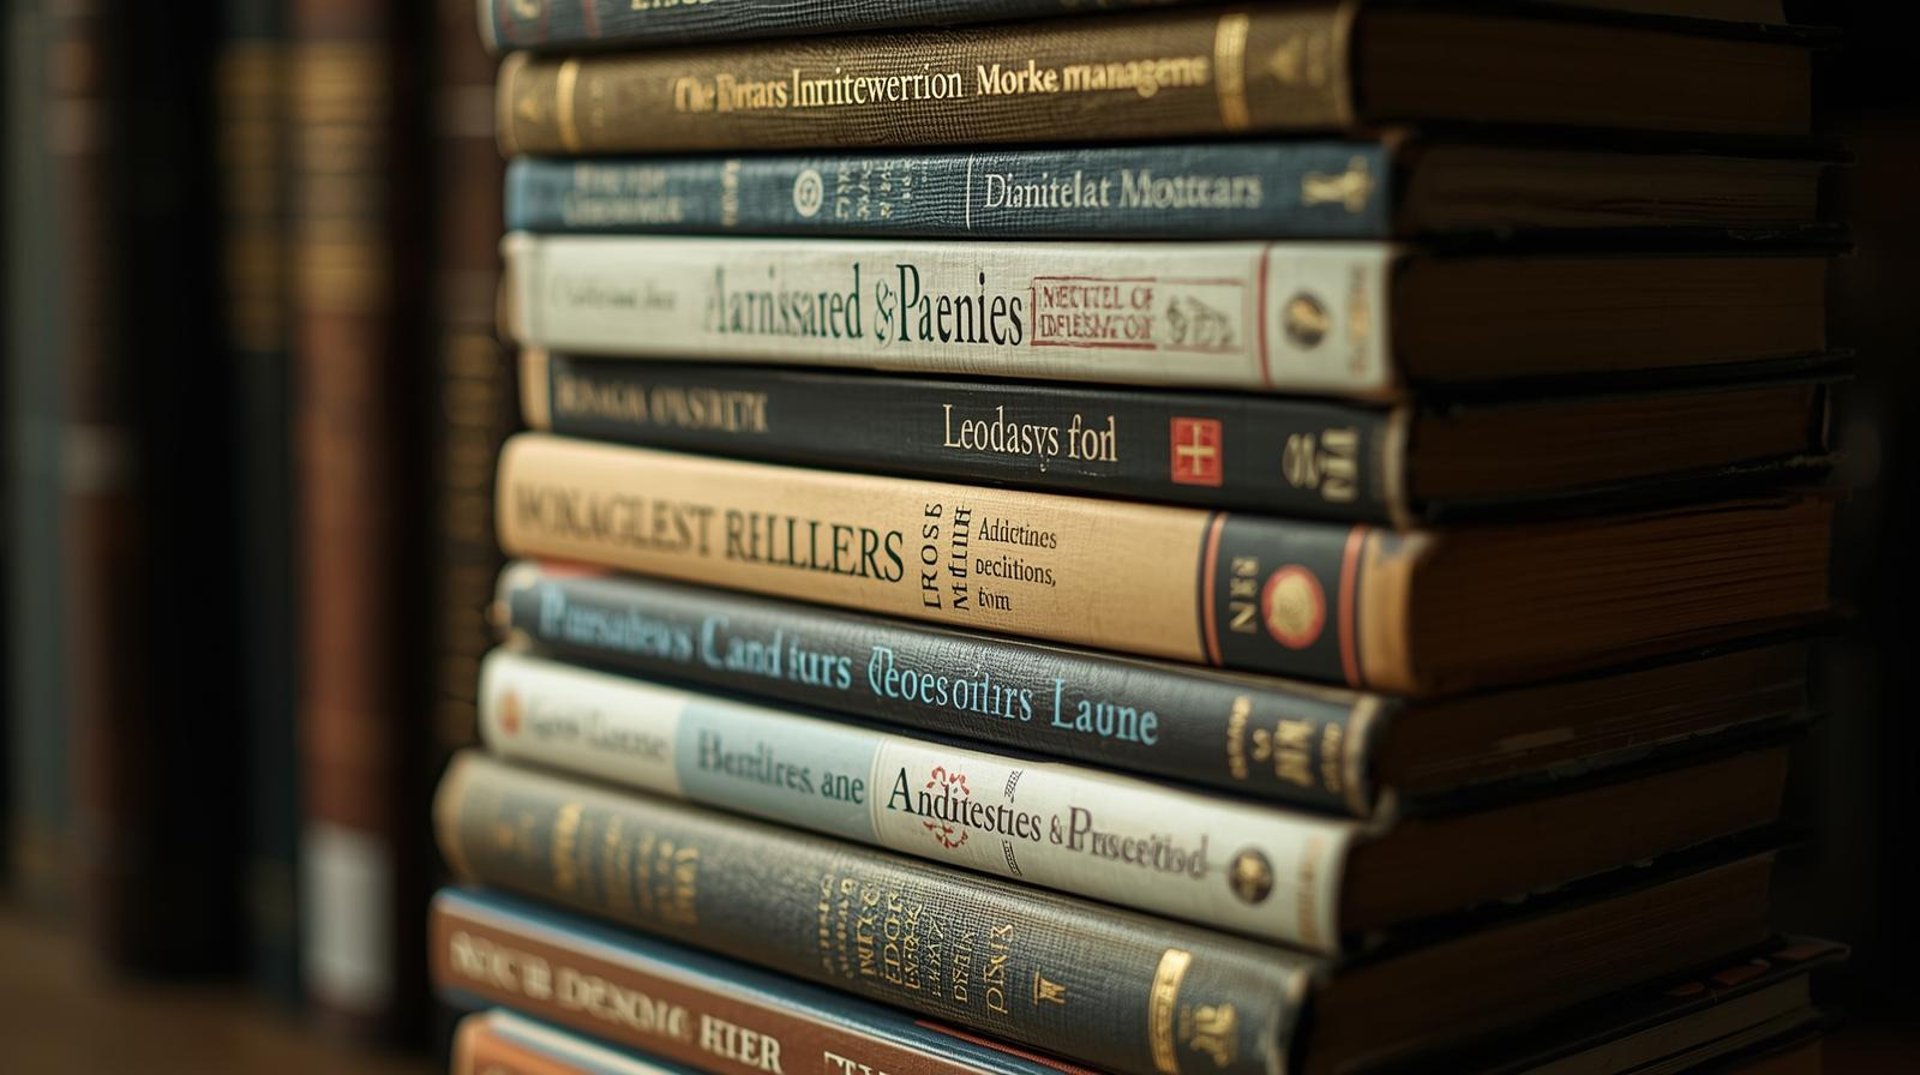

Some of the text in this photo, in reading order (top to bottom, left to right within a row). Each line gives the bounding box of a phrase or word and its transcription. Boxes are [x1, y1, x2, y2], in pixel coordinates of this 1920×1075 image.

[976, 60, 1058, 95] Morke
[896, 264, 1023, 346] Paenies
[1051, 678, 1158, 745] Laune
[1049, 814, 1063, 845] &
